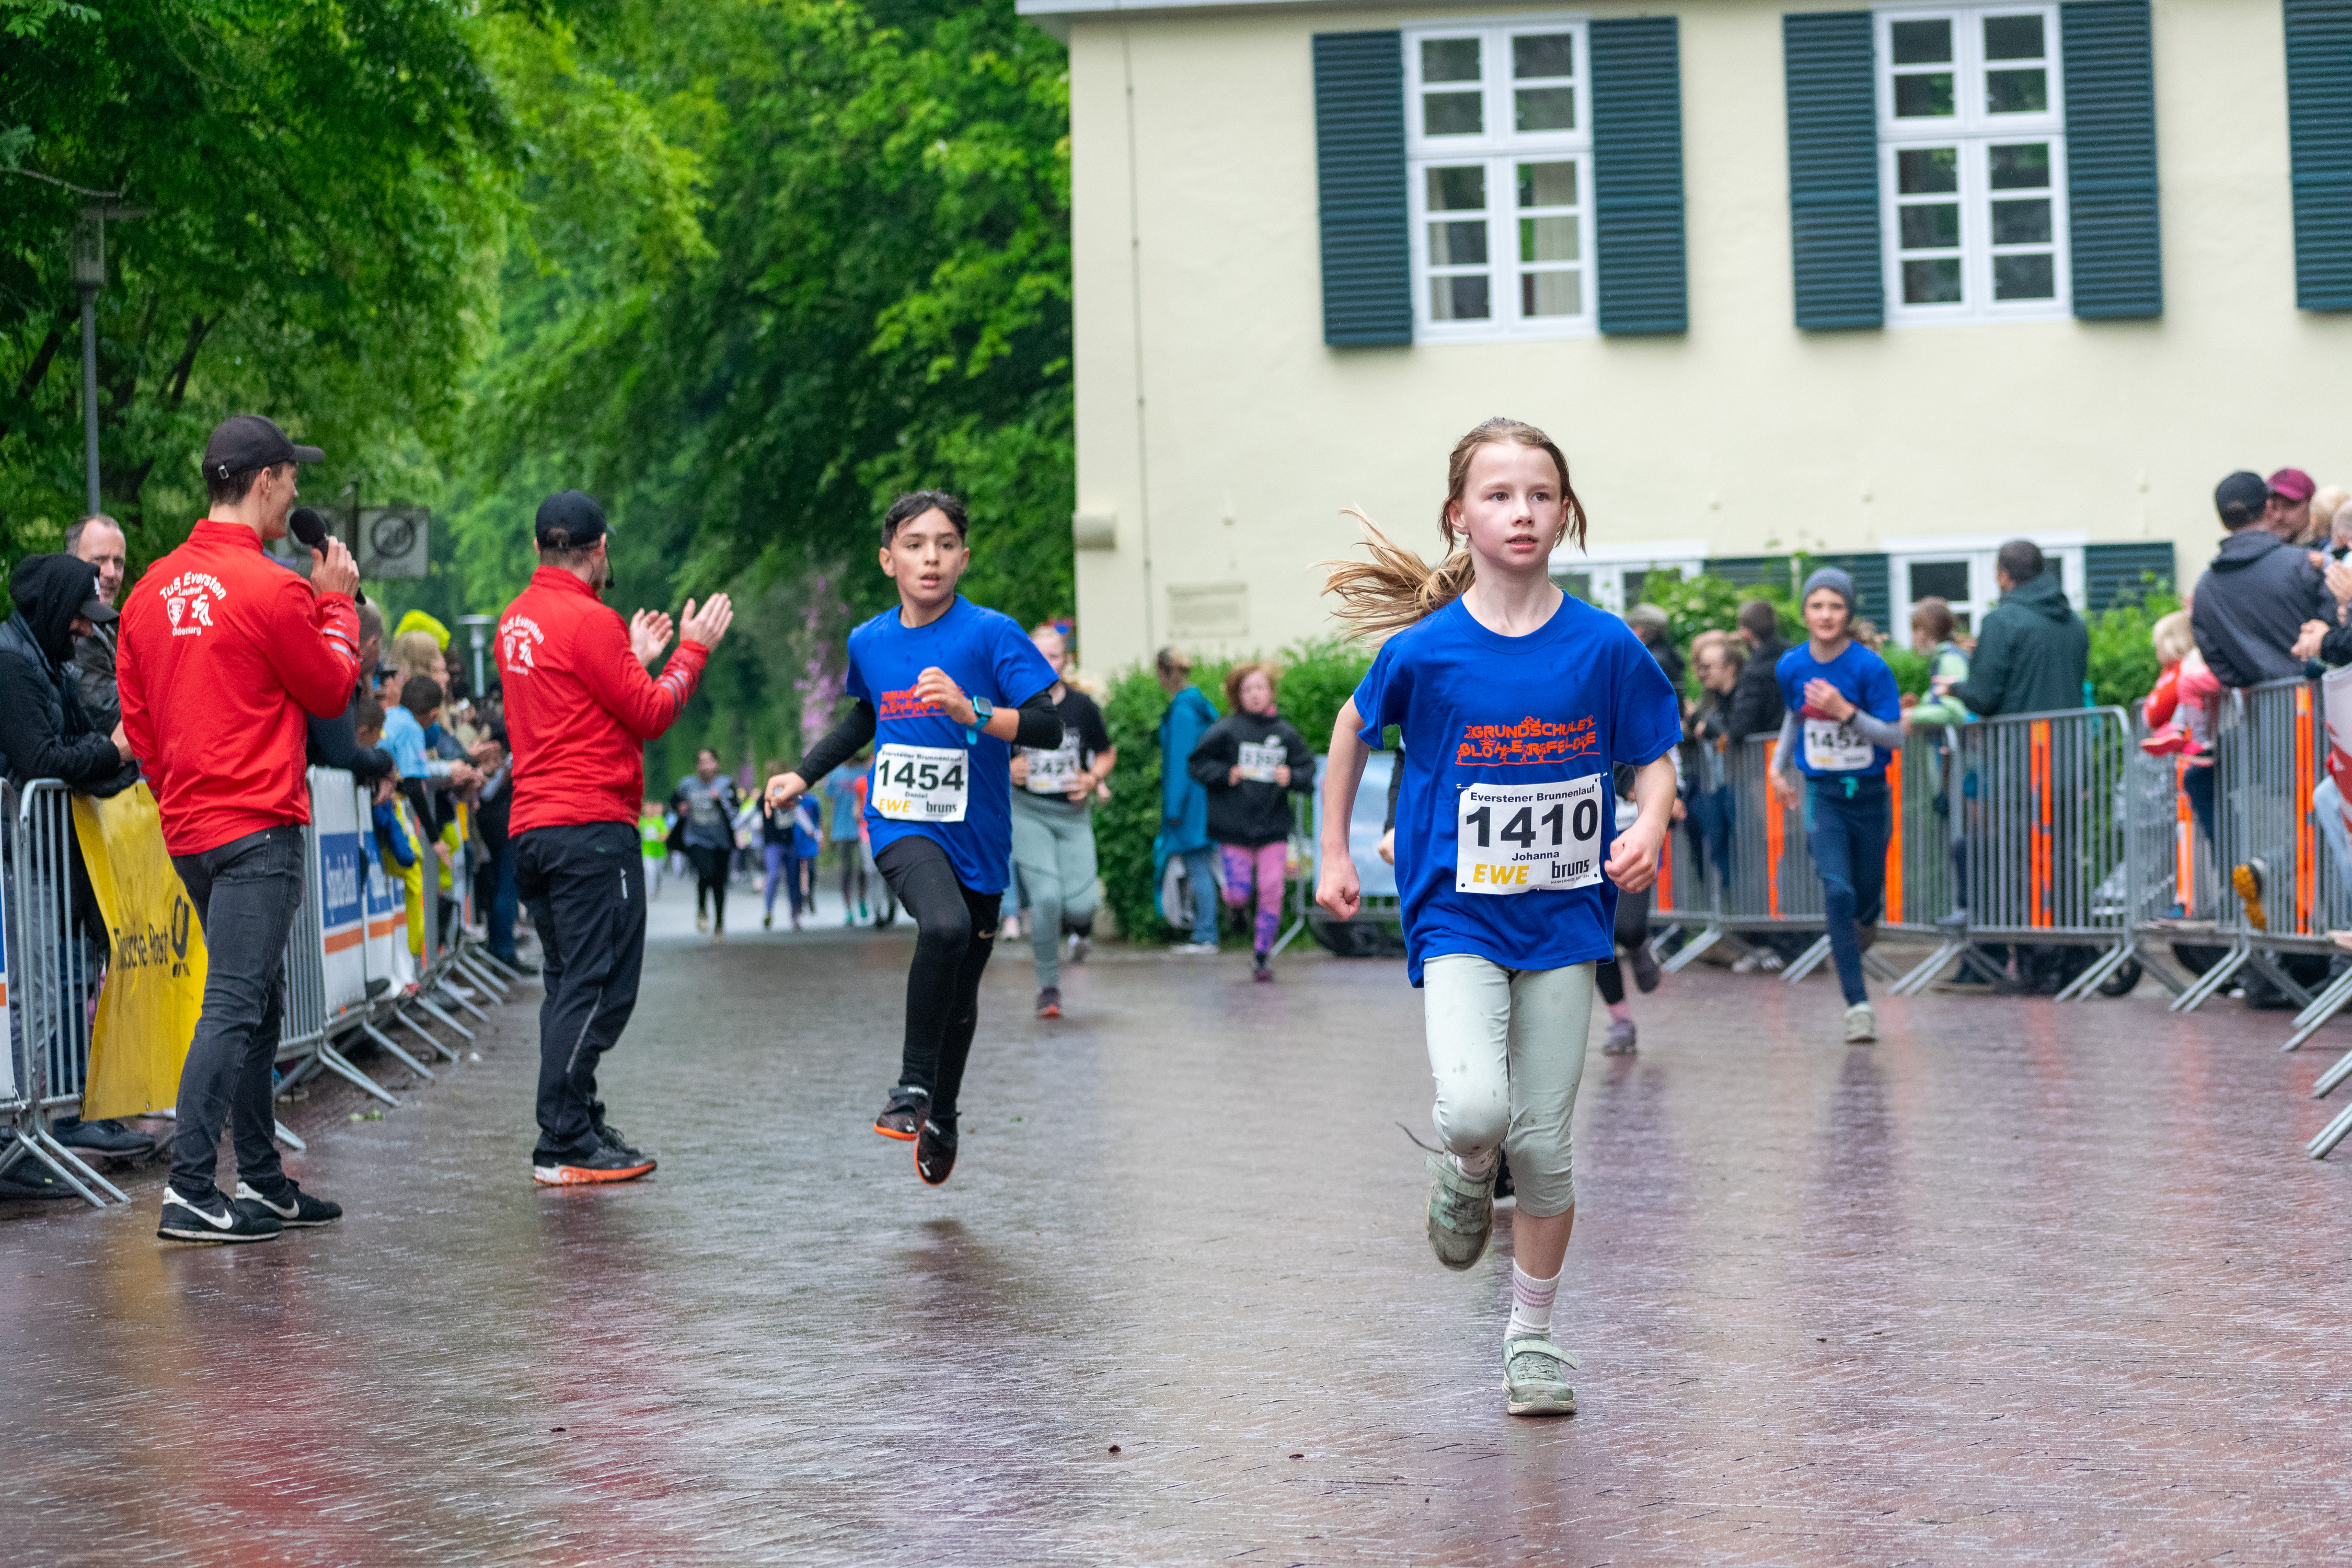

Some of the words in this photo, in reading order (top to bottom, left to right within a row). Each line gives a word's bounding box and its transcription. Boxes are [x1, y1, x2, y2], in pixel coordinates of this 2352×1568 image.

[160, 577, 180, 600] TuS
[183, 571, 226, 600] Eversten
[879, 759, 964, 791] 1454
[1470, 792, 1533, 802] Everstener
[1537, 783, 1595, 801] Brunnenlauf
[878, 798, 912, 812] EWE
[926, 801, 957, 813] bruns
[1466, 799, 1598, 848] 1410
[1512, 851, 1559, 861] Johanna
[1472, 863, 1529, 884] EWE
[1551, 859, 1589, 878] bruns
[148, 923, 168, 965] Post
